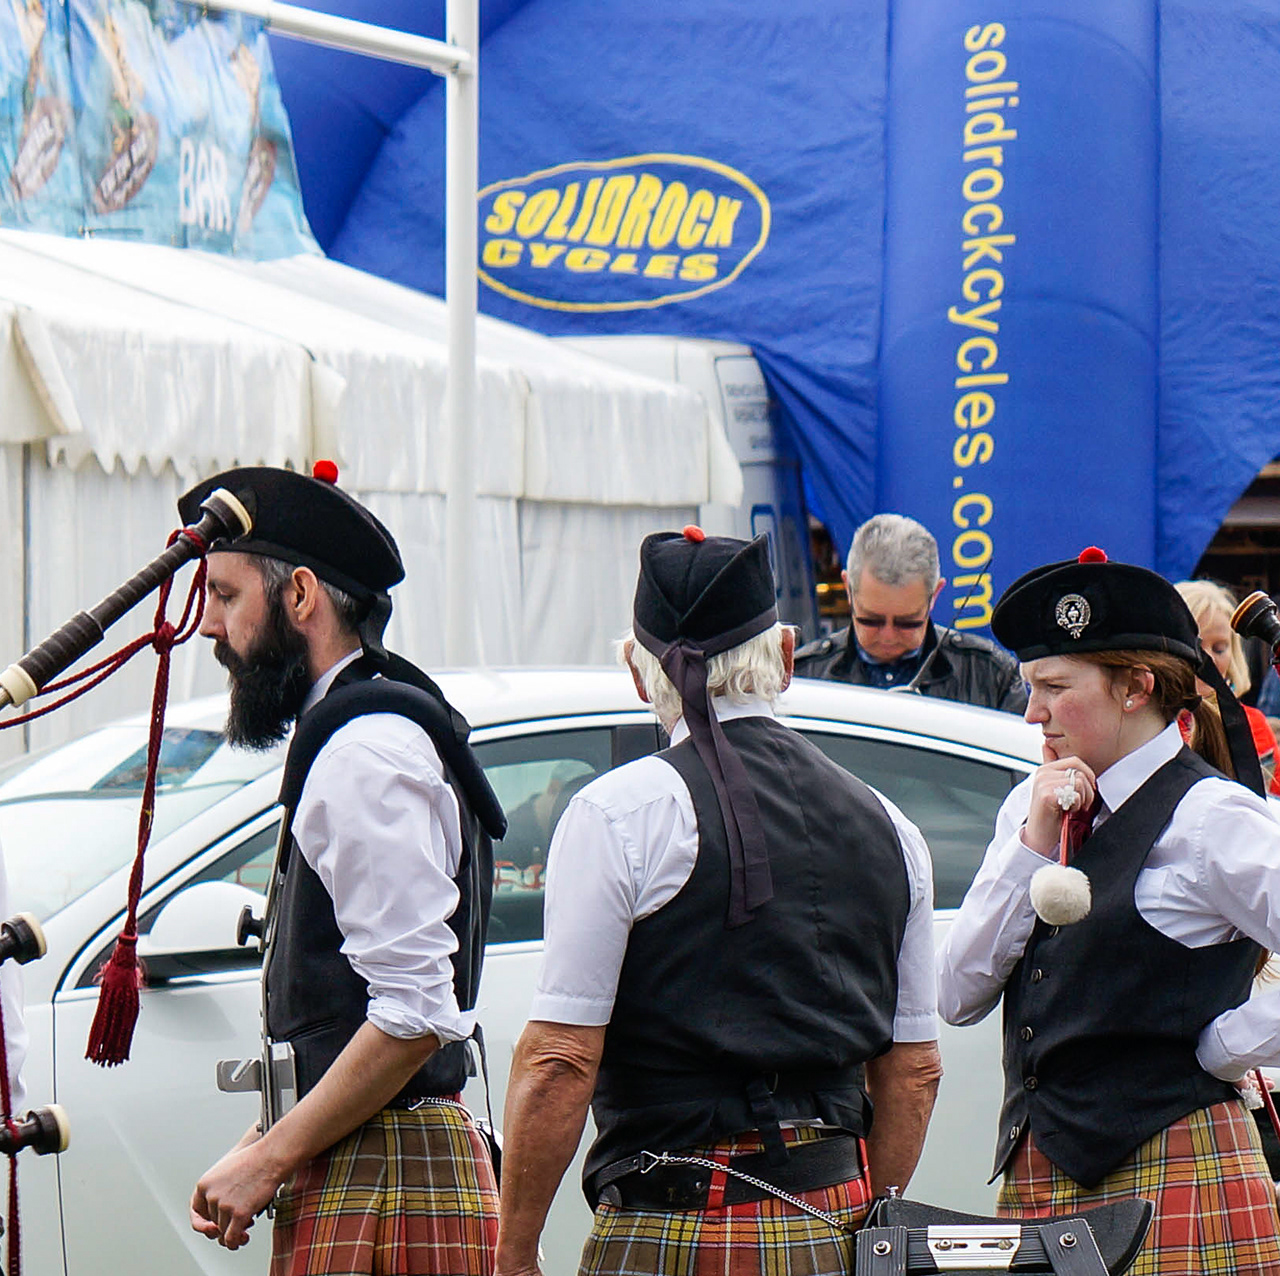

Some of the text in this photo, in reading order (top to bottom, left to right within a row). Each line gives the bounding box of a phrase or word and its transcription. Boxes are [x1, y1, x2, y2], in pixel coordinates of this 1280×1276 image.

[179, 136, 233, 233] BAR
[484, 173, 742, 250] SOLIDROCK
[482, 239, 719, 281] CYCLES
[947, 22, 1020, 630] solidrockcycles.com
